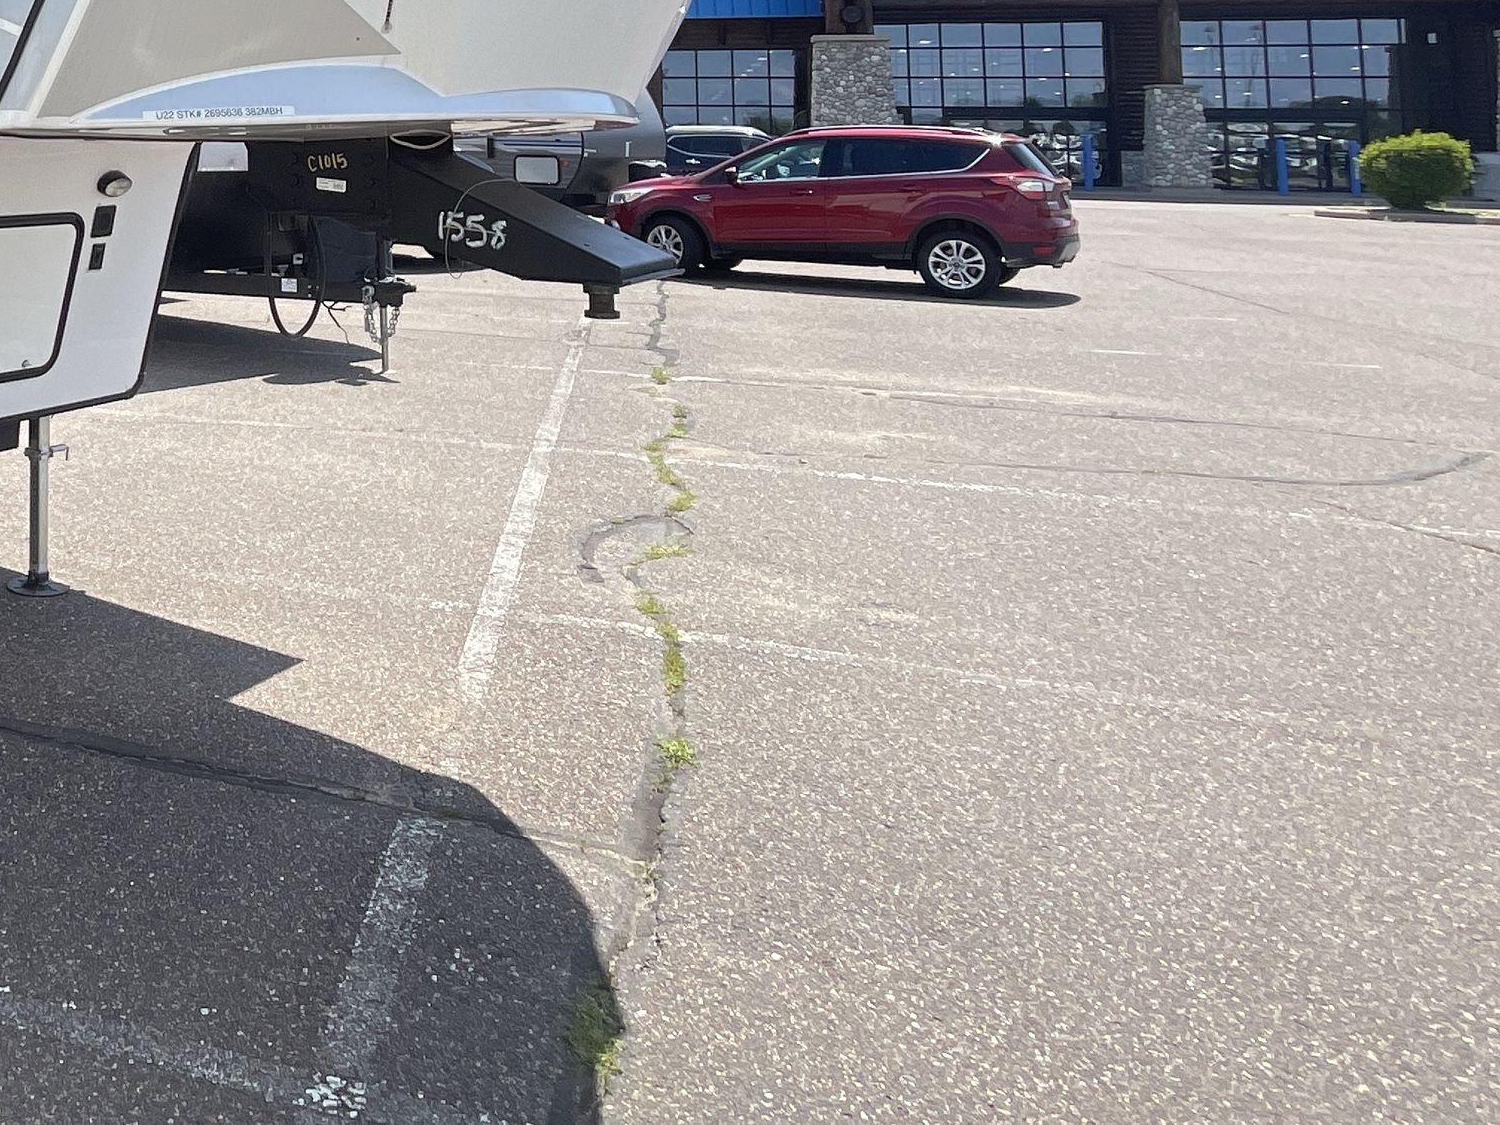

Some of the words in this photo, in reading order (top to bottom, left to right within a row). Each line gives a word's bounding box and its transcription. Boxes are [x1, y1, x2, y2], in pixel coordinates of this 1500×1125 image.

[156, 110, 174, 120] U22
[176, 109, 202, 119] STK#
[307, 152, 348, 172] C1015
[438, 211, 507, 250] 1558
